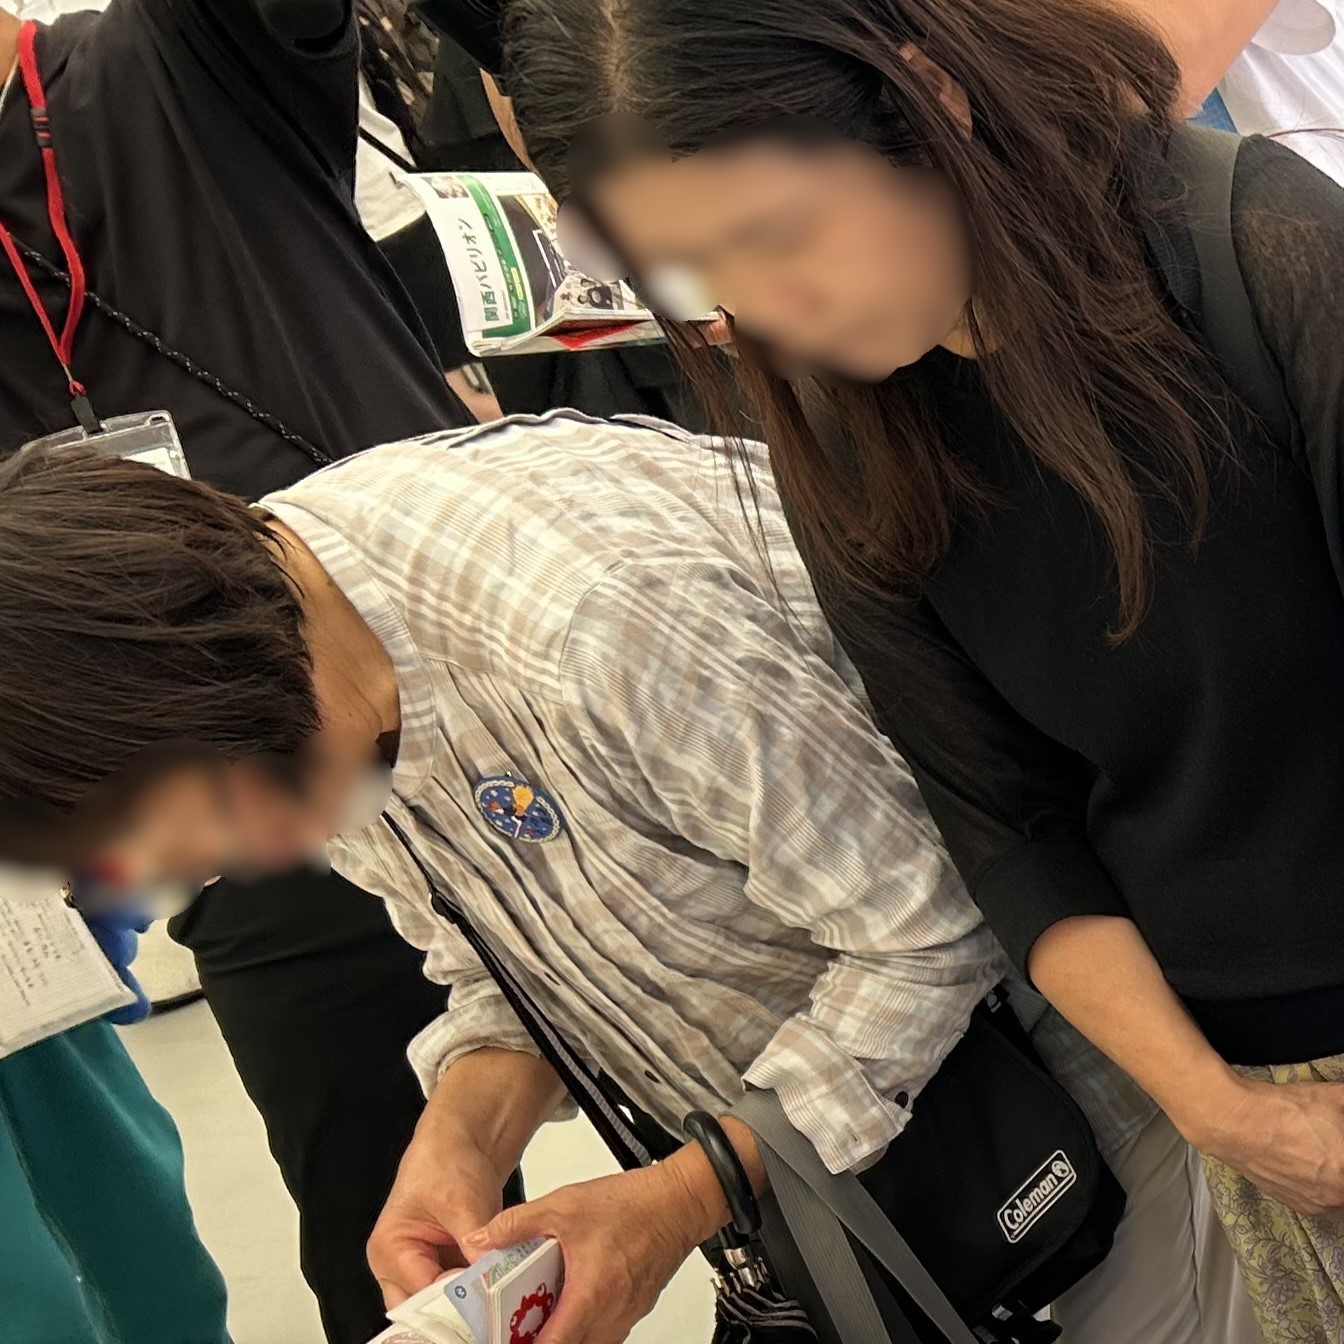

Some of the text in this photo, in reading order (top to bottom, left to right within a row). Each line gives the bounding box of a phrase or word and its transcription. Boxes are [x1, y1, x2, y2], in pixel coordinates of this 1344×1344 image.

[458, 217, 500, 322] 関西パビリオン
[1004, 1173, 1058, 1230] Coleman
